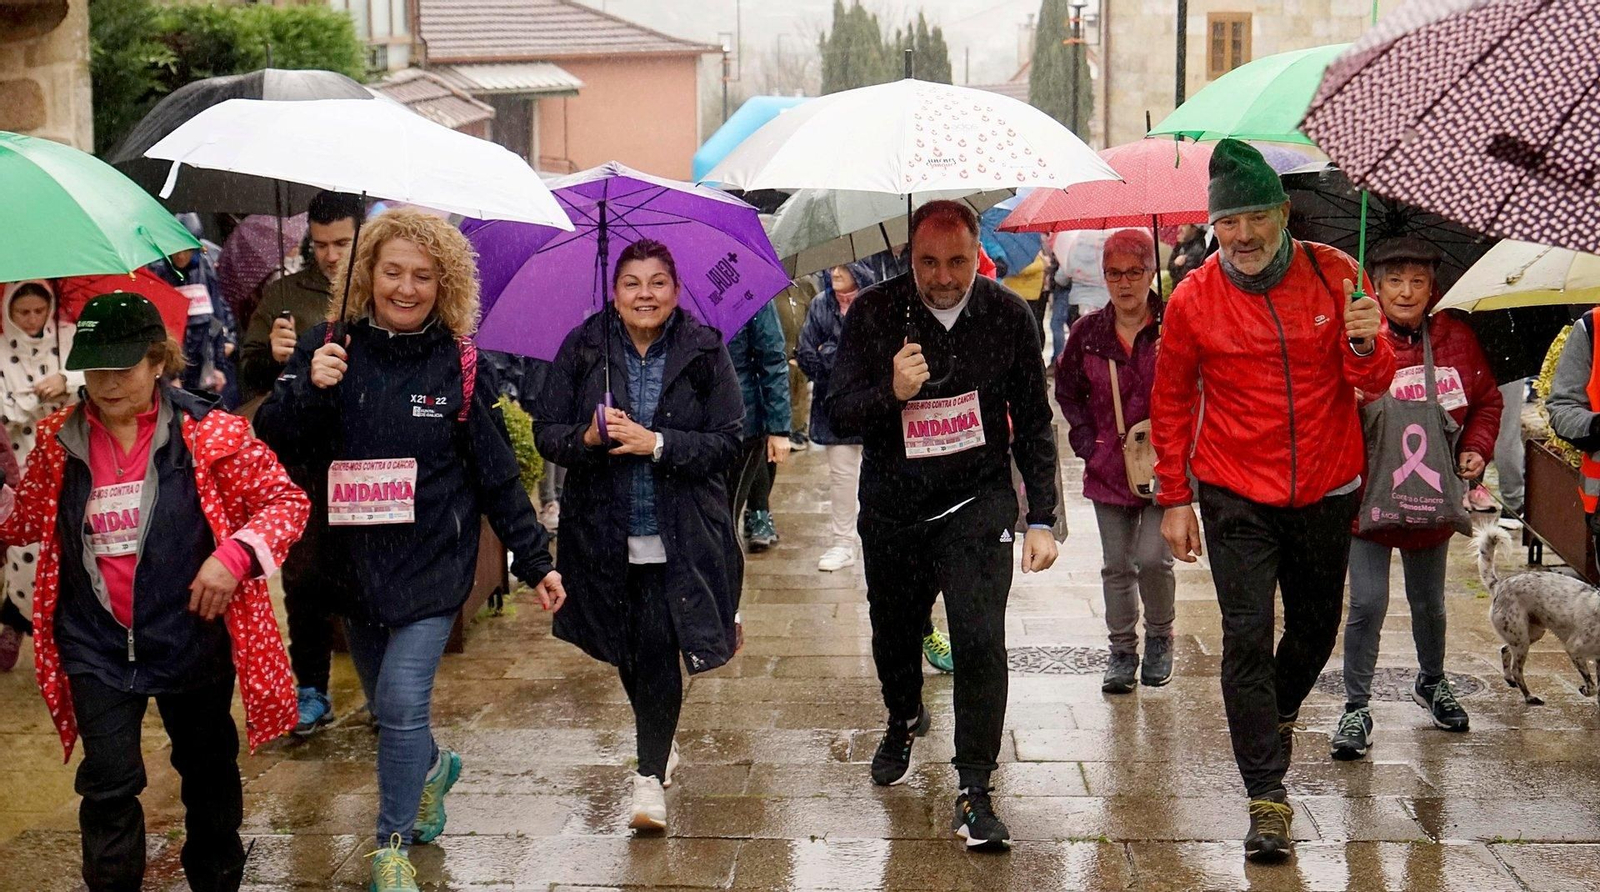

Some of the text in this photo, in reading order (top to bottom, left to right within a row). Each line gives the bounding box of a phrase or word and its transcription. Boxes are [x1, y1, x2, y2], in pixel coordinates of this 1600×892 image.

[435, 396, 447, 405] 22
[932, 400, 952, 409] CONTRA
[363, 461, 386, 470] CONTRA
[387, 461, 392, 470] O
[109, 485, 134, 497] CONTRA
[135, 484, 140, 493] O
[1391, 492, 1413, 502] Contra
[1419, 496, 1444, 504] Cancro
